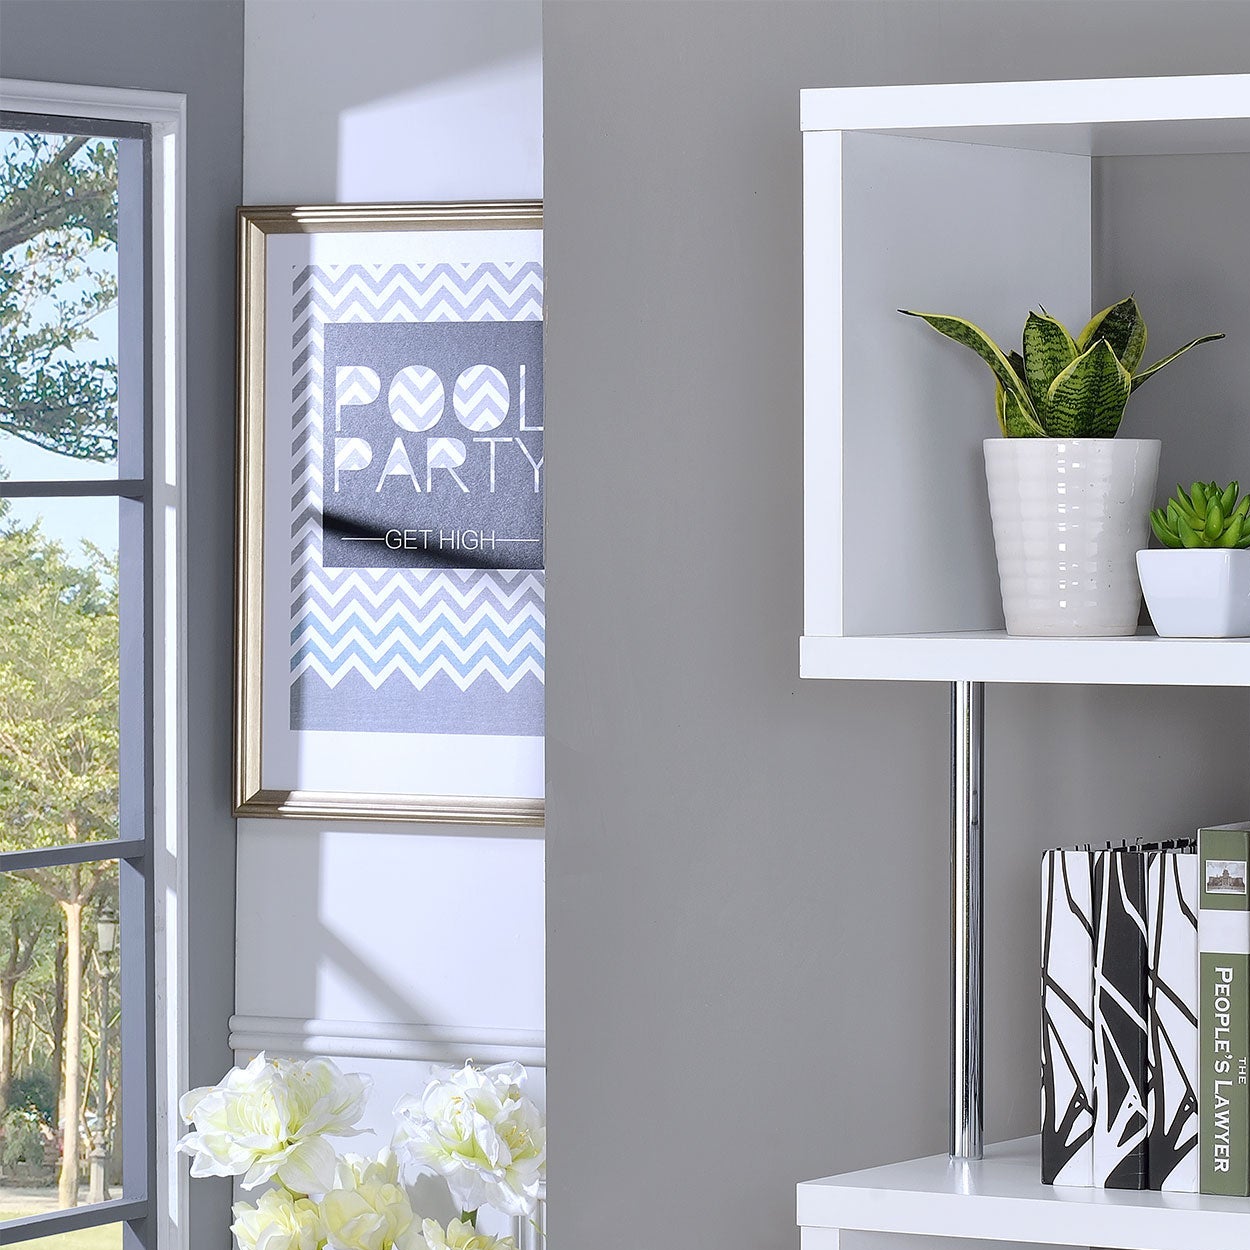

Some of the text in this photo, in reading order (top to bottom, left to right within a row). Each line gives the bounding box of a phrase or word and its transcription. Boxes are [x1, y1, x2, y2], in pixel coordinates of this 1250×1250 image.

[335, 364, 544, 432] POOL
[334, 437, 544, 493] PARTY
[385, 529, 495, 550] GET HIGH
[1213, 966, 1234, 1172] PEOPLE'S LAWYER
[1238, 1057, 1247, 1084] THE
